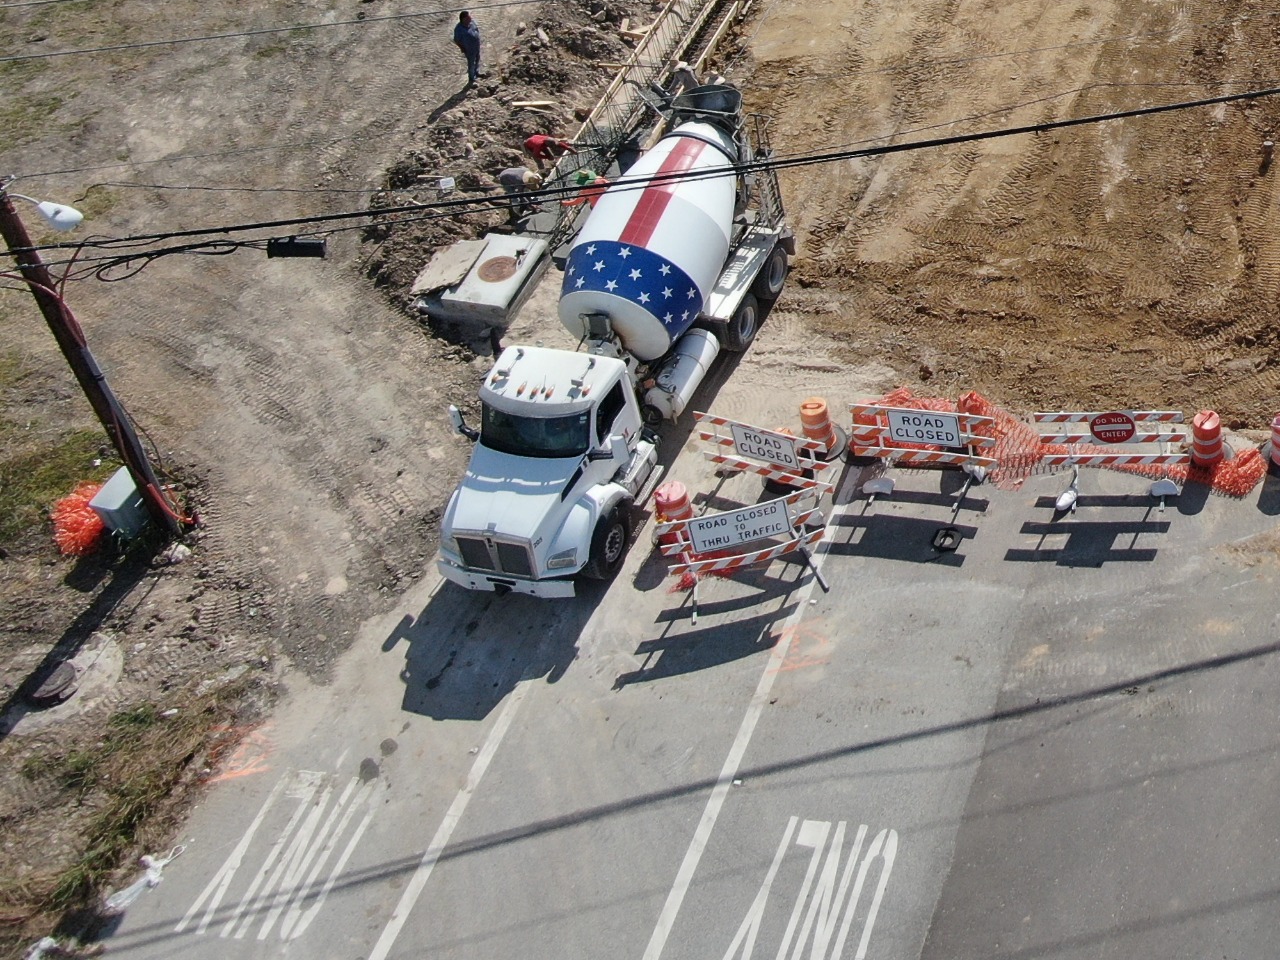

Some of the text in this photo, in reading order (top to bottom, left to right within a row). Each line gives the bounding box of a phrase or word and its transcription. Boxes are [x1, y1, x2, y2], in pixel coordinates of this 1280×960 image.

[902, 416, 944, 429] ROAD
[743, 432, 782, 450] ROAD
[895, 427, 954, 442] CLOSED
[1101, 430, 1127, 438] ENTER
[740, 442, 793, 465] CLOSED
[698, 506, 777, 531] ROAD CLOSED
[702, 522, 782, 548] THRU TRAFFIC
[734, 523, 746, 532] TO
